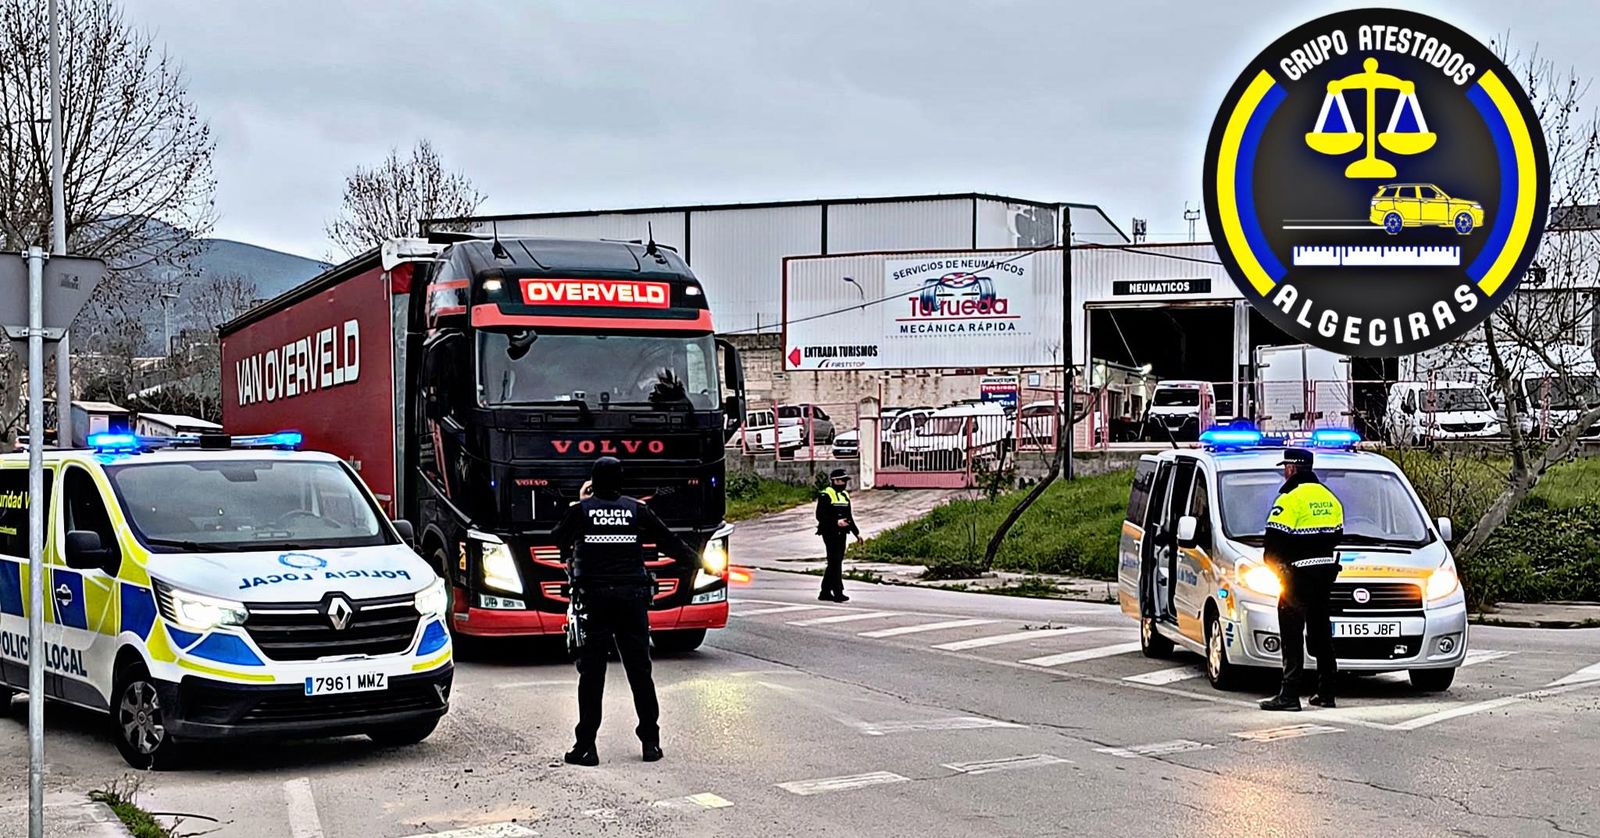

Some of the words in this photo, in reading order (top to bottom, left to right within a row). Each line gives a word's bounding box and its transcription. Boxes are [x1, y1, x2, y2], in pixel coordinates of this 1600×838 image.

[893, 261, 944, 280] SERVICIOS
[946, 260, 959, 268] DE
[527, 282, 664, 304] OVERVELD
[1129, 281, 1190, 293] NEUMATICOS
[909, 297, 932, 317] Tu
[940, 296, 1008, 316] rueda
[900, 323, 965, 333] MECÁNICA
[969, 322, 1016, 332] RÁPIDA
[804, 346, 838, 358] ENTRADA
[839, 345, 878, 357] TURISMOS
[236, 353, 263, 405] VAN
[265, 319, 360, 401] OVERVELD
[551, 440, 665, 453] VOLVO
[0, 490, 23, 509] uridad
[589, 509, 633, 518] POLICIA
[593, 517, 630, 526] LOCAL
[1340, 624, 1369, 635] 1165
[1374, 624, 1396, 635] JBF
[0, 630, 30, 661] OLIC
[44, 641, 87, 677] LOCAL
[315, 676, 352, 692] 7961
[357, 673, 384, 689] MMZ
